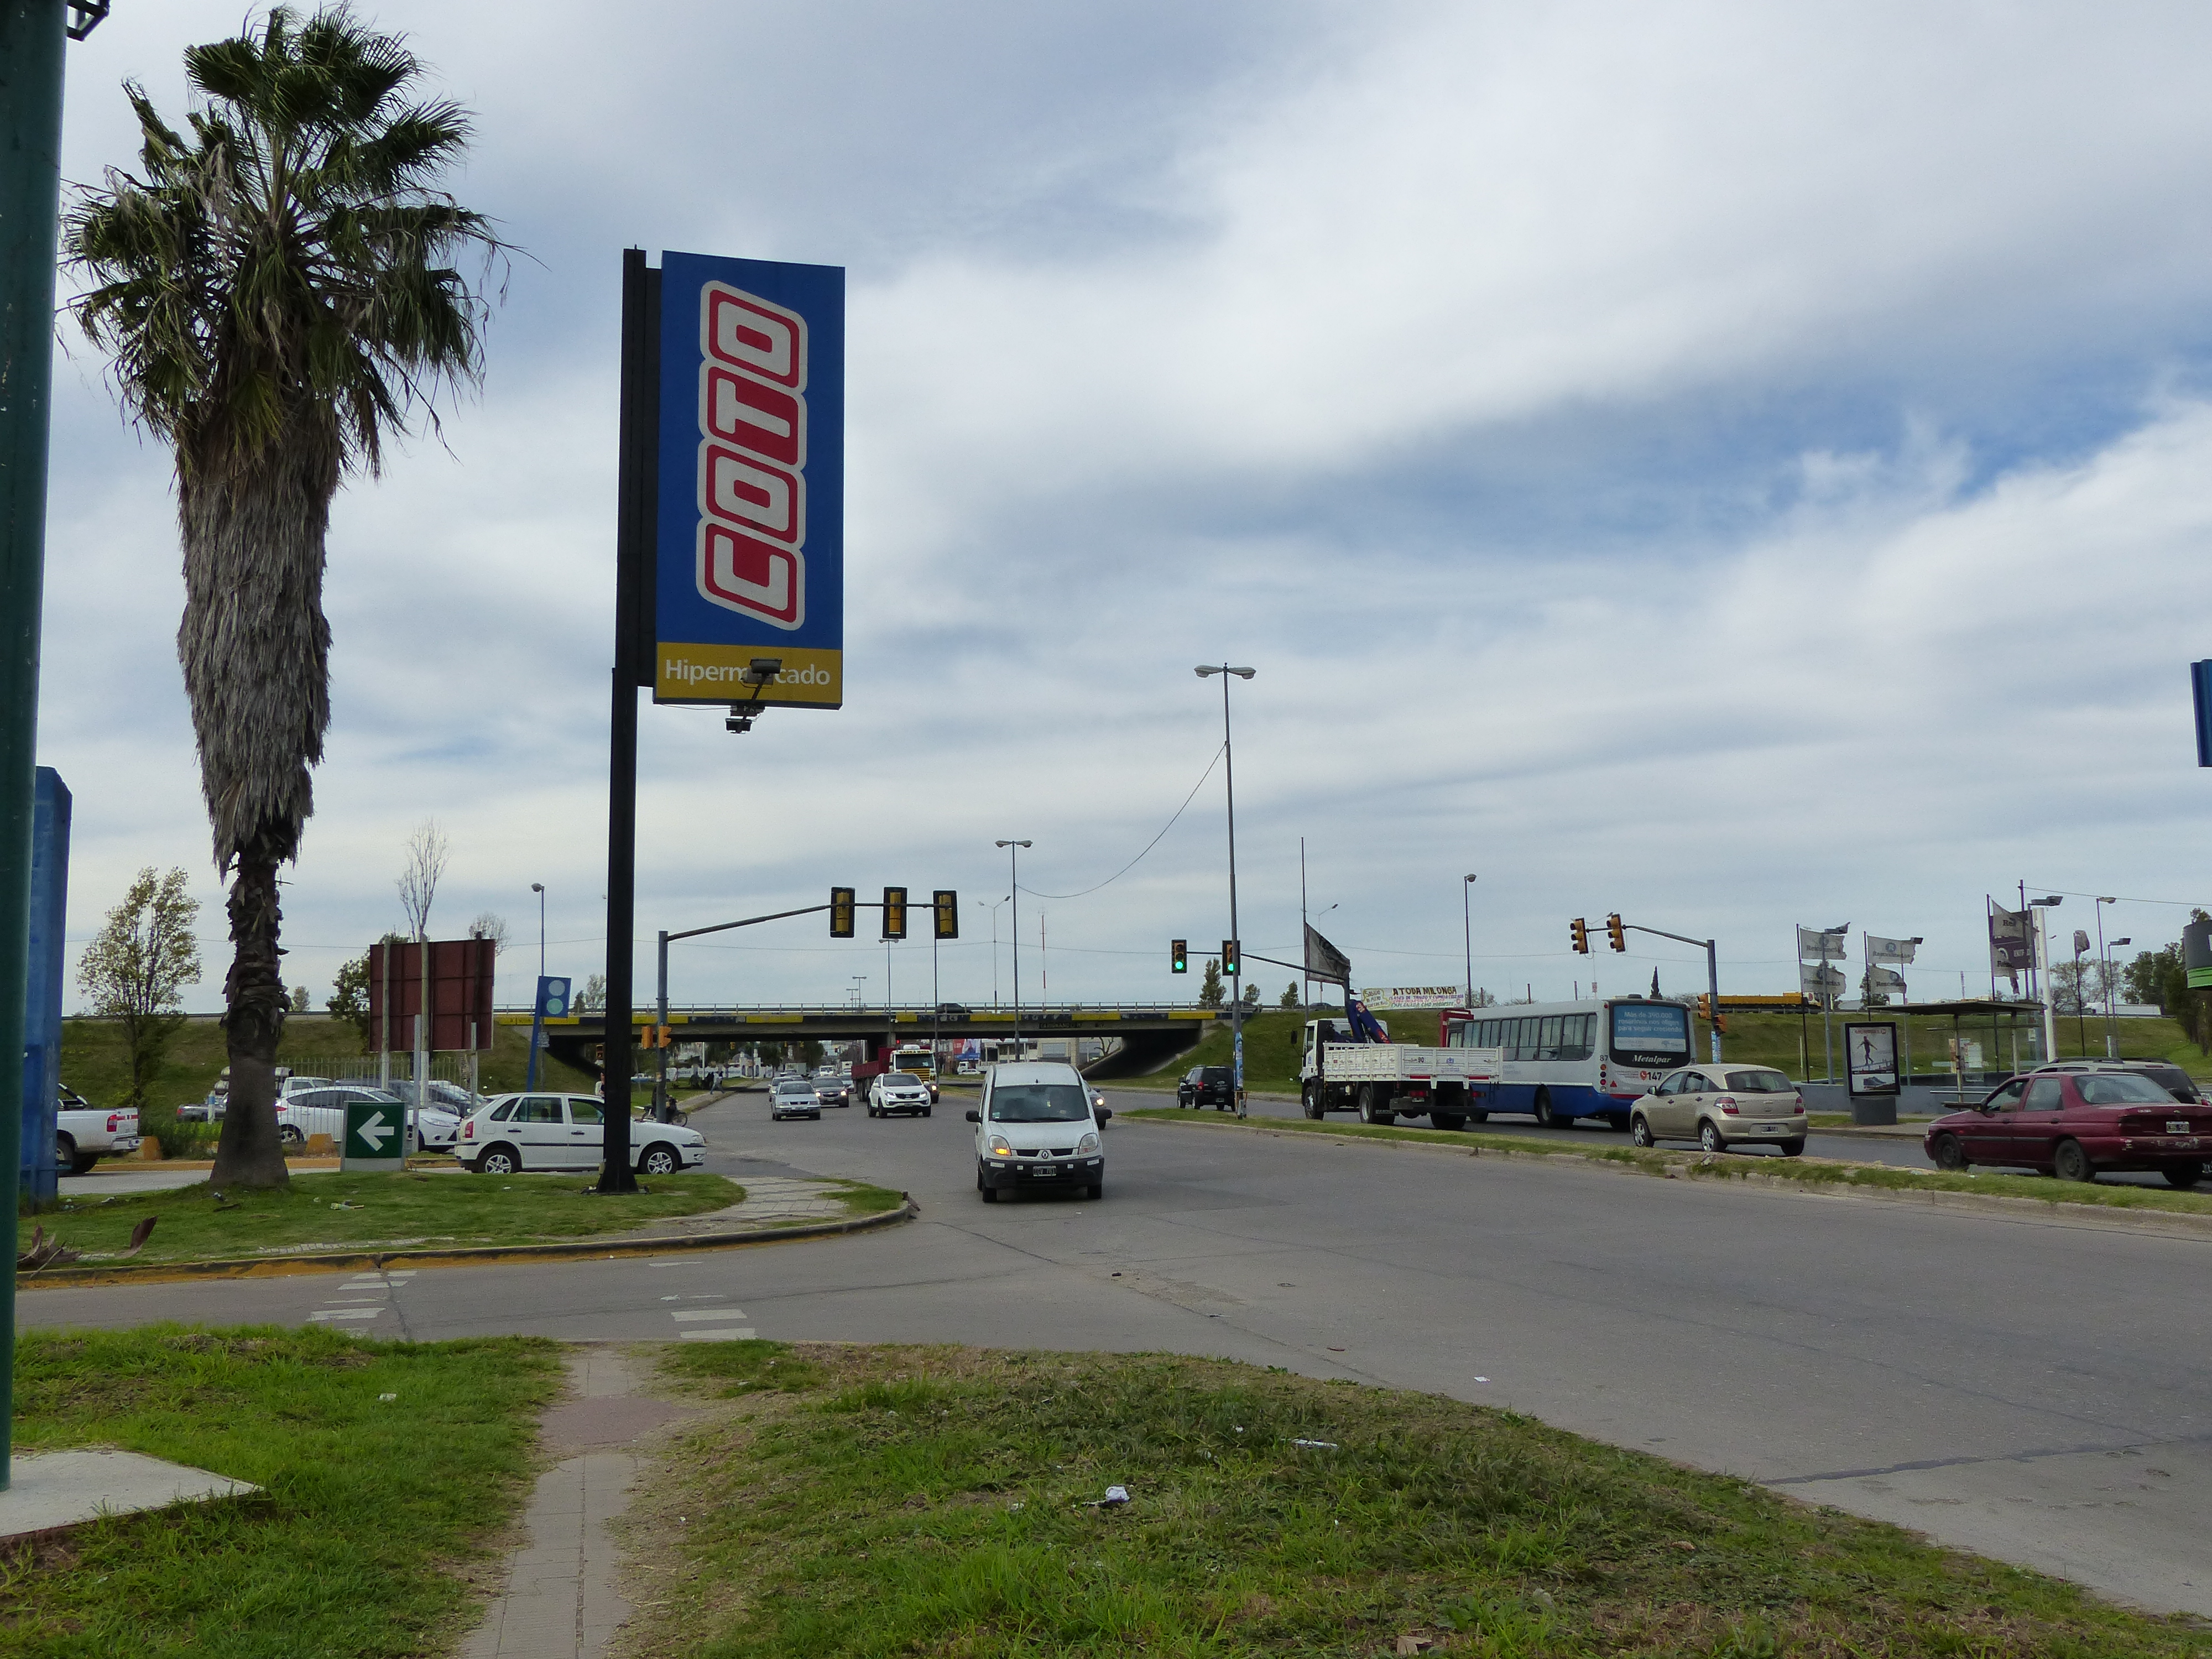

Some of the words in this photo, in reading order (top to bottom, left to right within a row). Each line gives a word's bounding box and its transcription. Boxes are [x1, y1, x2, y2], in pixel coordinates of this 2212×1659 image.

[702, 285, 802, 626] COTO
[666, 659, 830, 685] Hipermcado
[1423, 987, 1457, 995] MILONGA
[1632, 1055, 1672, 1064] Metalpar
[1647, 1072, 1662, 1080] 147
